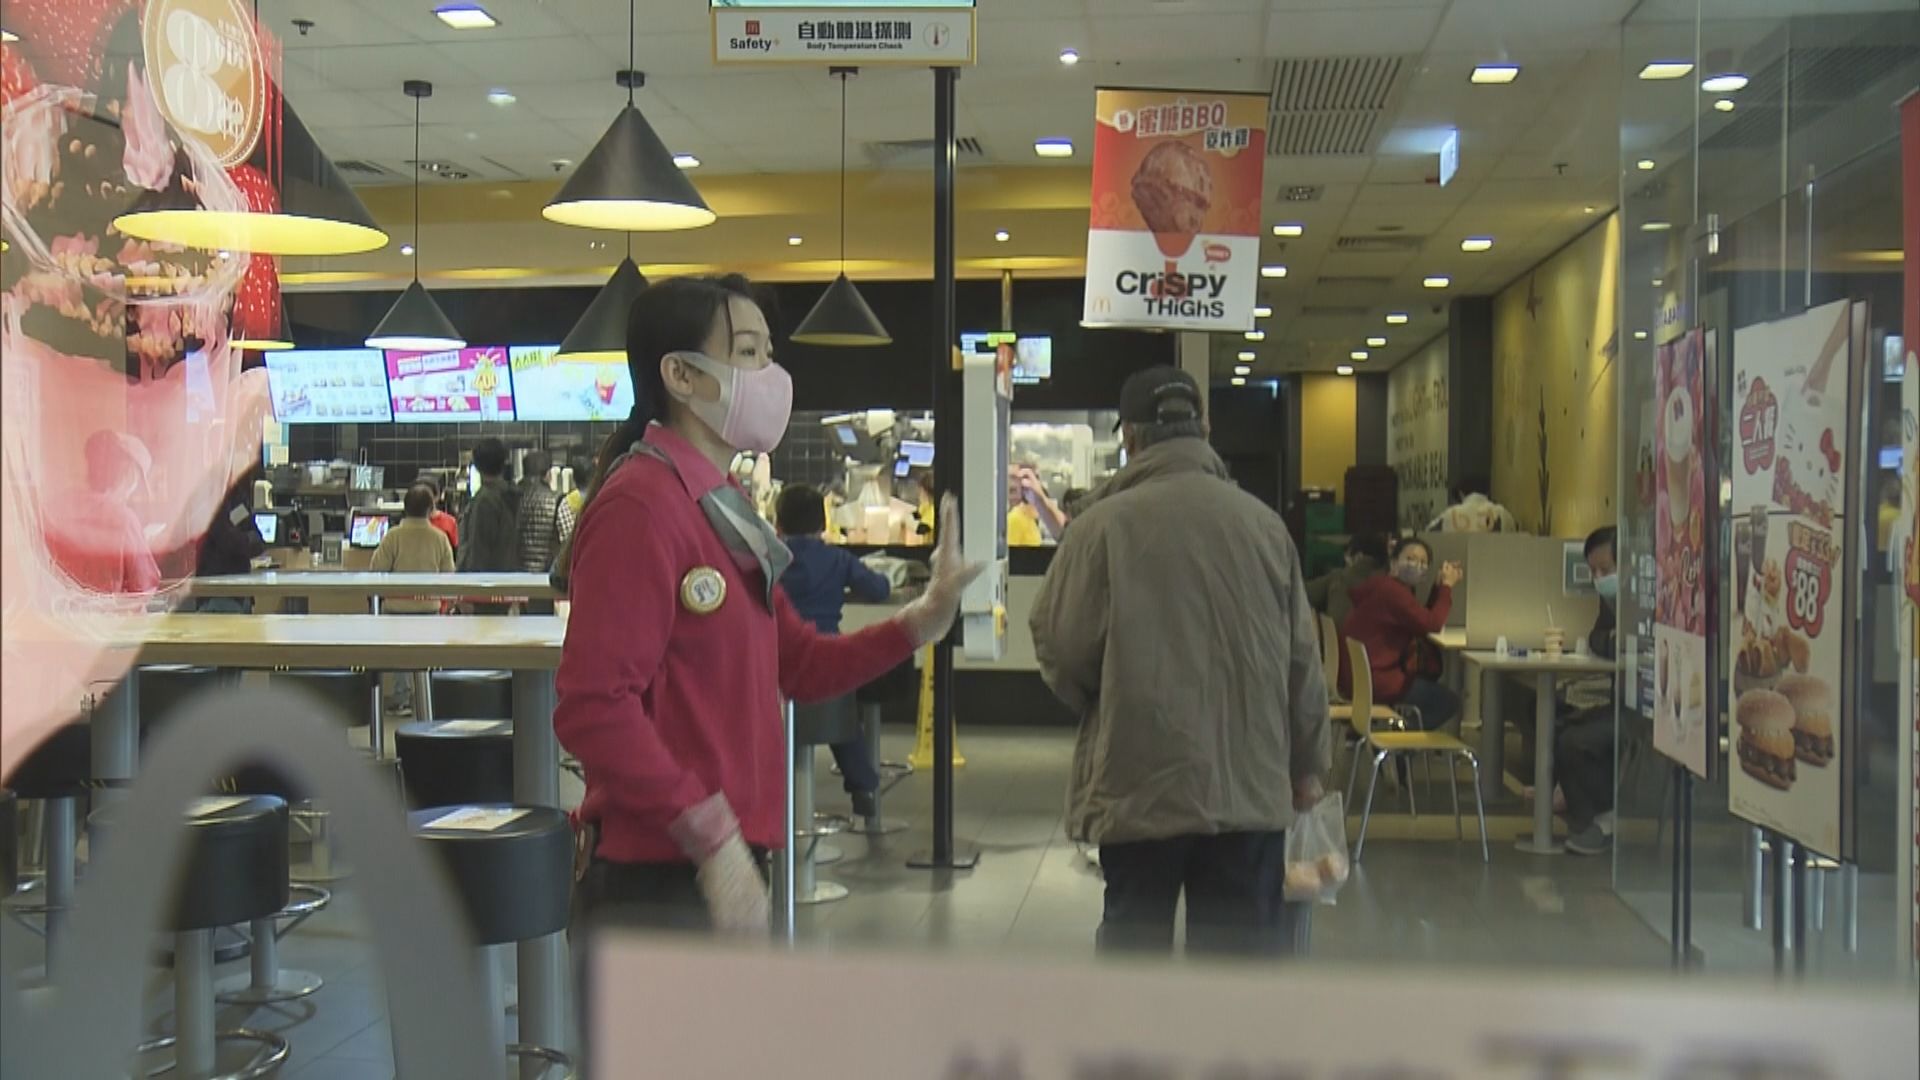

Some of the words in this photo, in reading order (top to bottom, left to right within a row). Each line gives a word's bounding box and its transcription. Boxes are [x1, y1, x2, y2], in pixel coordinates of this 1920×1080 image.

[807, 42, 826, 50] Body
[828, 42, 877, 50] Temperature
[878, 42, 903, 50] Check
[1792, 569, 1820, 624] $88
